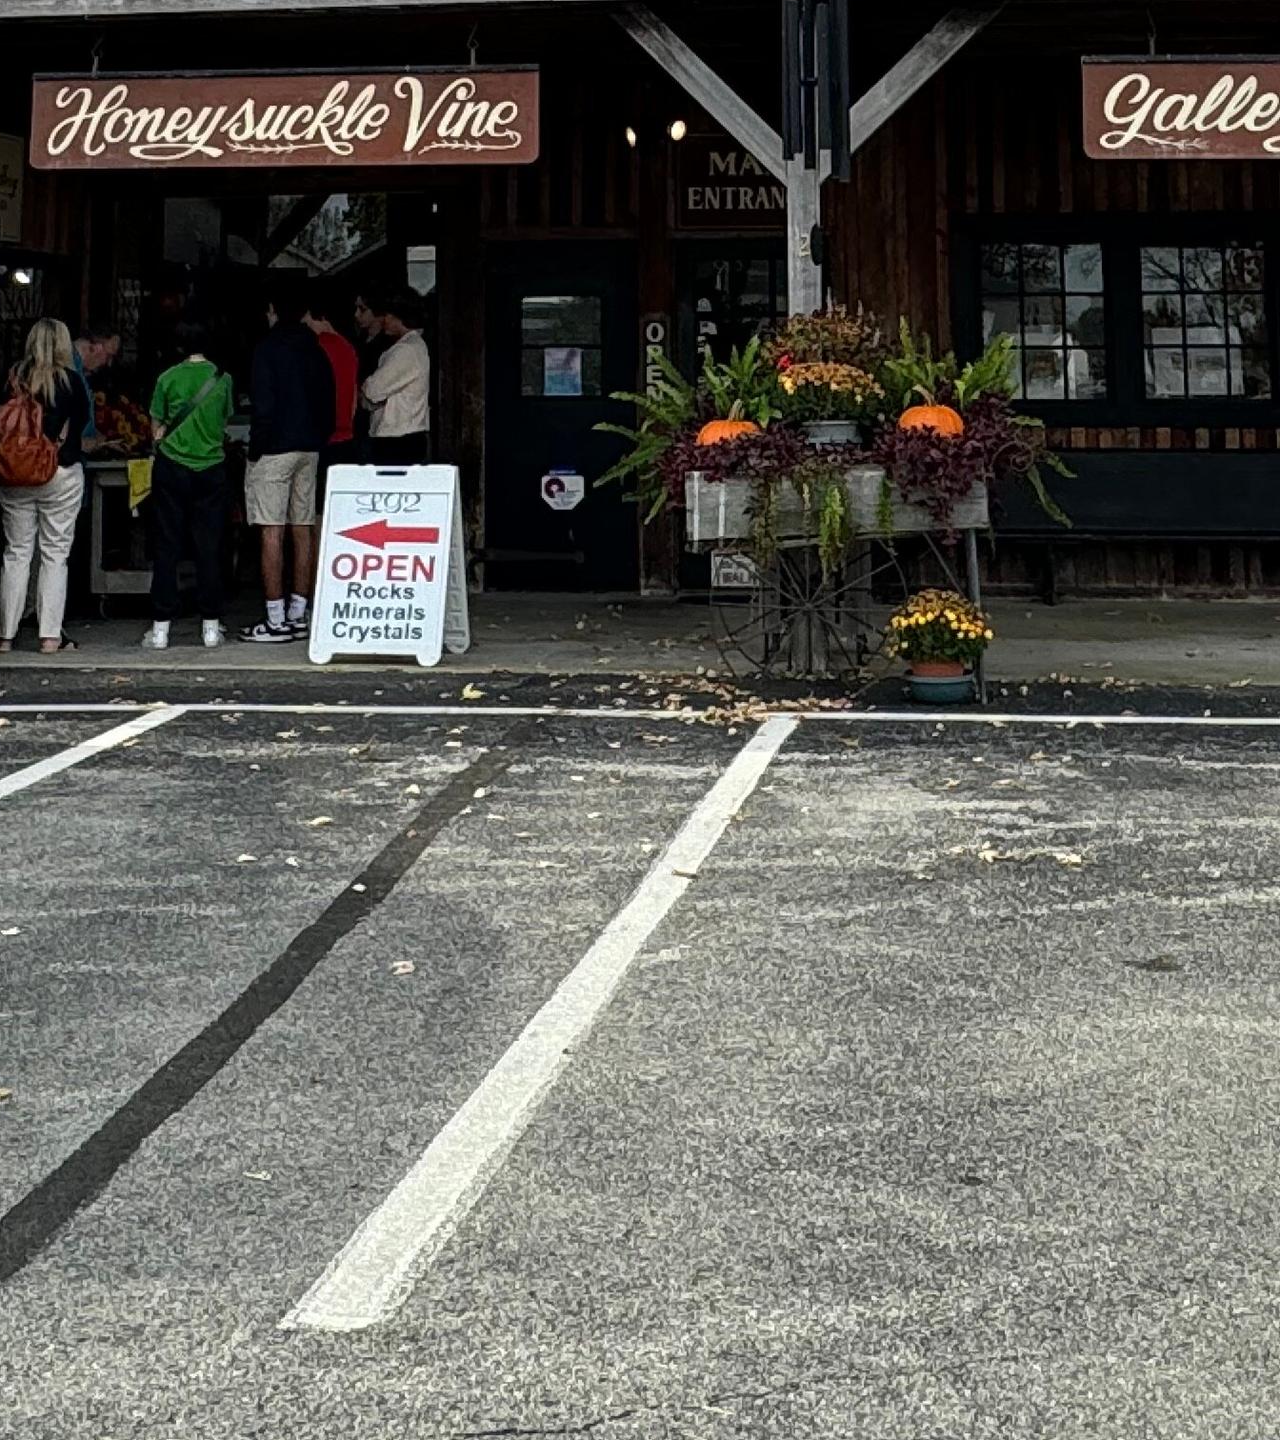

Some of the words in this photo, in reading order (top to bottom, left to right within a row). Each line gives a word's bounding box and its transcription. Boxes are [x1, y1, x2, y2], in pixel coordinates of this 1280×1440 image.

[46, 79, 390, 160] Honeysuckle
[394, 76, 522, 155] Vine
[708, 151, 766, 177] MA
[687, 186, 786, 210] ENTRAN
[331, 553, 436, 583] OPEN
[346, 582, 415, 600] Rocks
[332, 603, 426, 621] Minerals
[332, 621, 423, 643] Crystals
